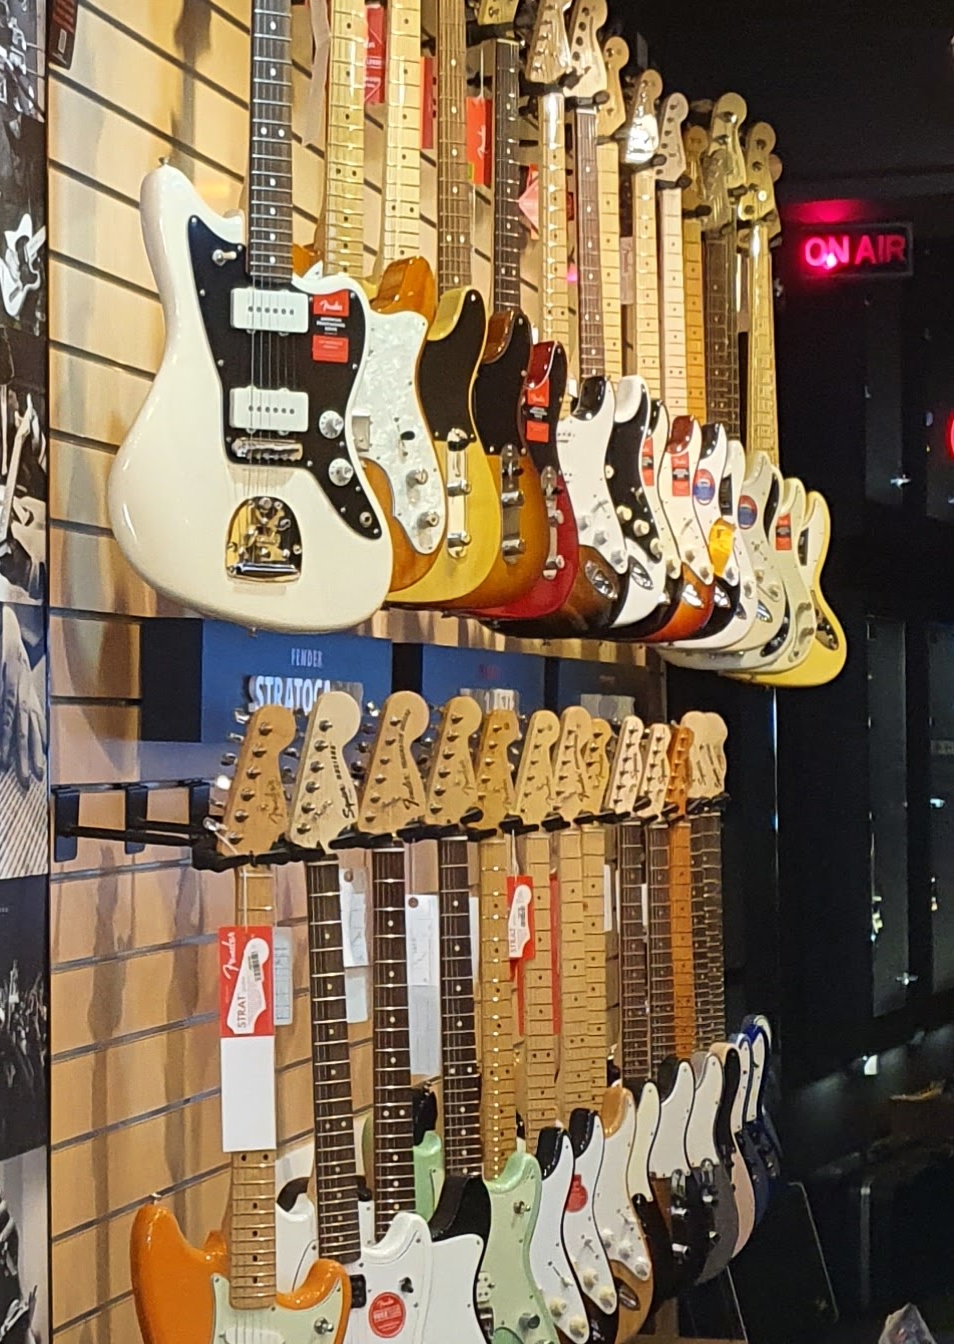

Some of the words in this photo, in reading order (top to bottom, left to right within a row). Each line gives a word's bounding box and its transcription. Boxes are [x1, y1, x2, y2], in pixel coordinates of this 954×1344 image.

[804, 235, 850, 267] ON
[855, 234, 906, 266] AIR
[291, 647, 323, 668] FENDER
[221, 931, 239, 980] Fender
[237, 995, 247, 1029] STRAT
